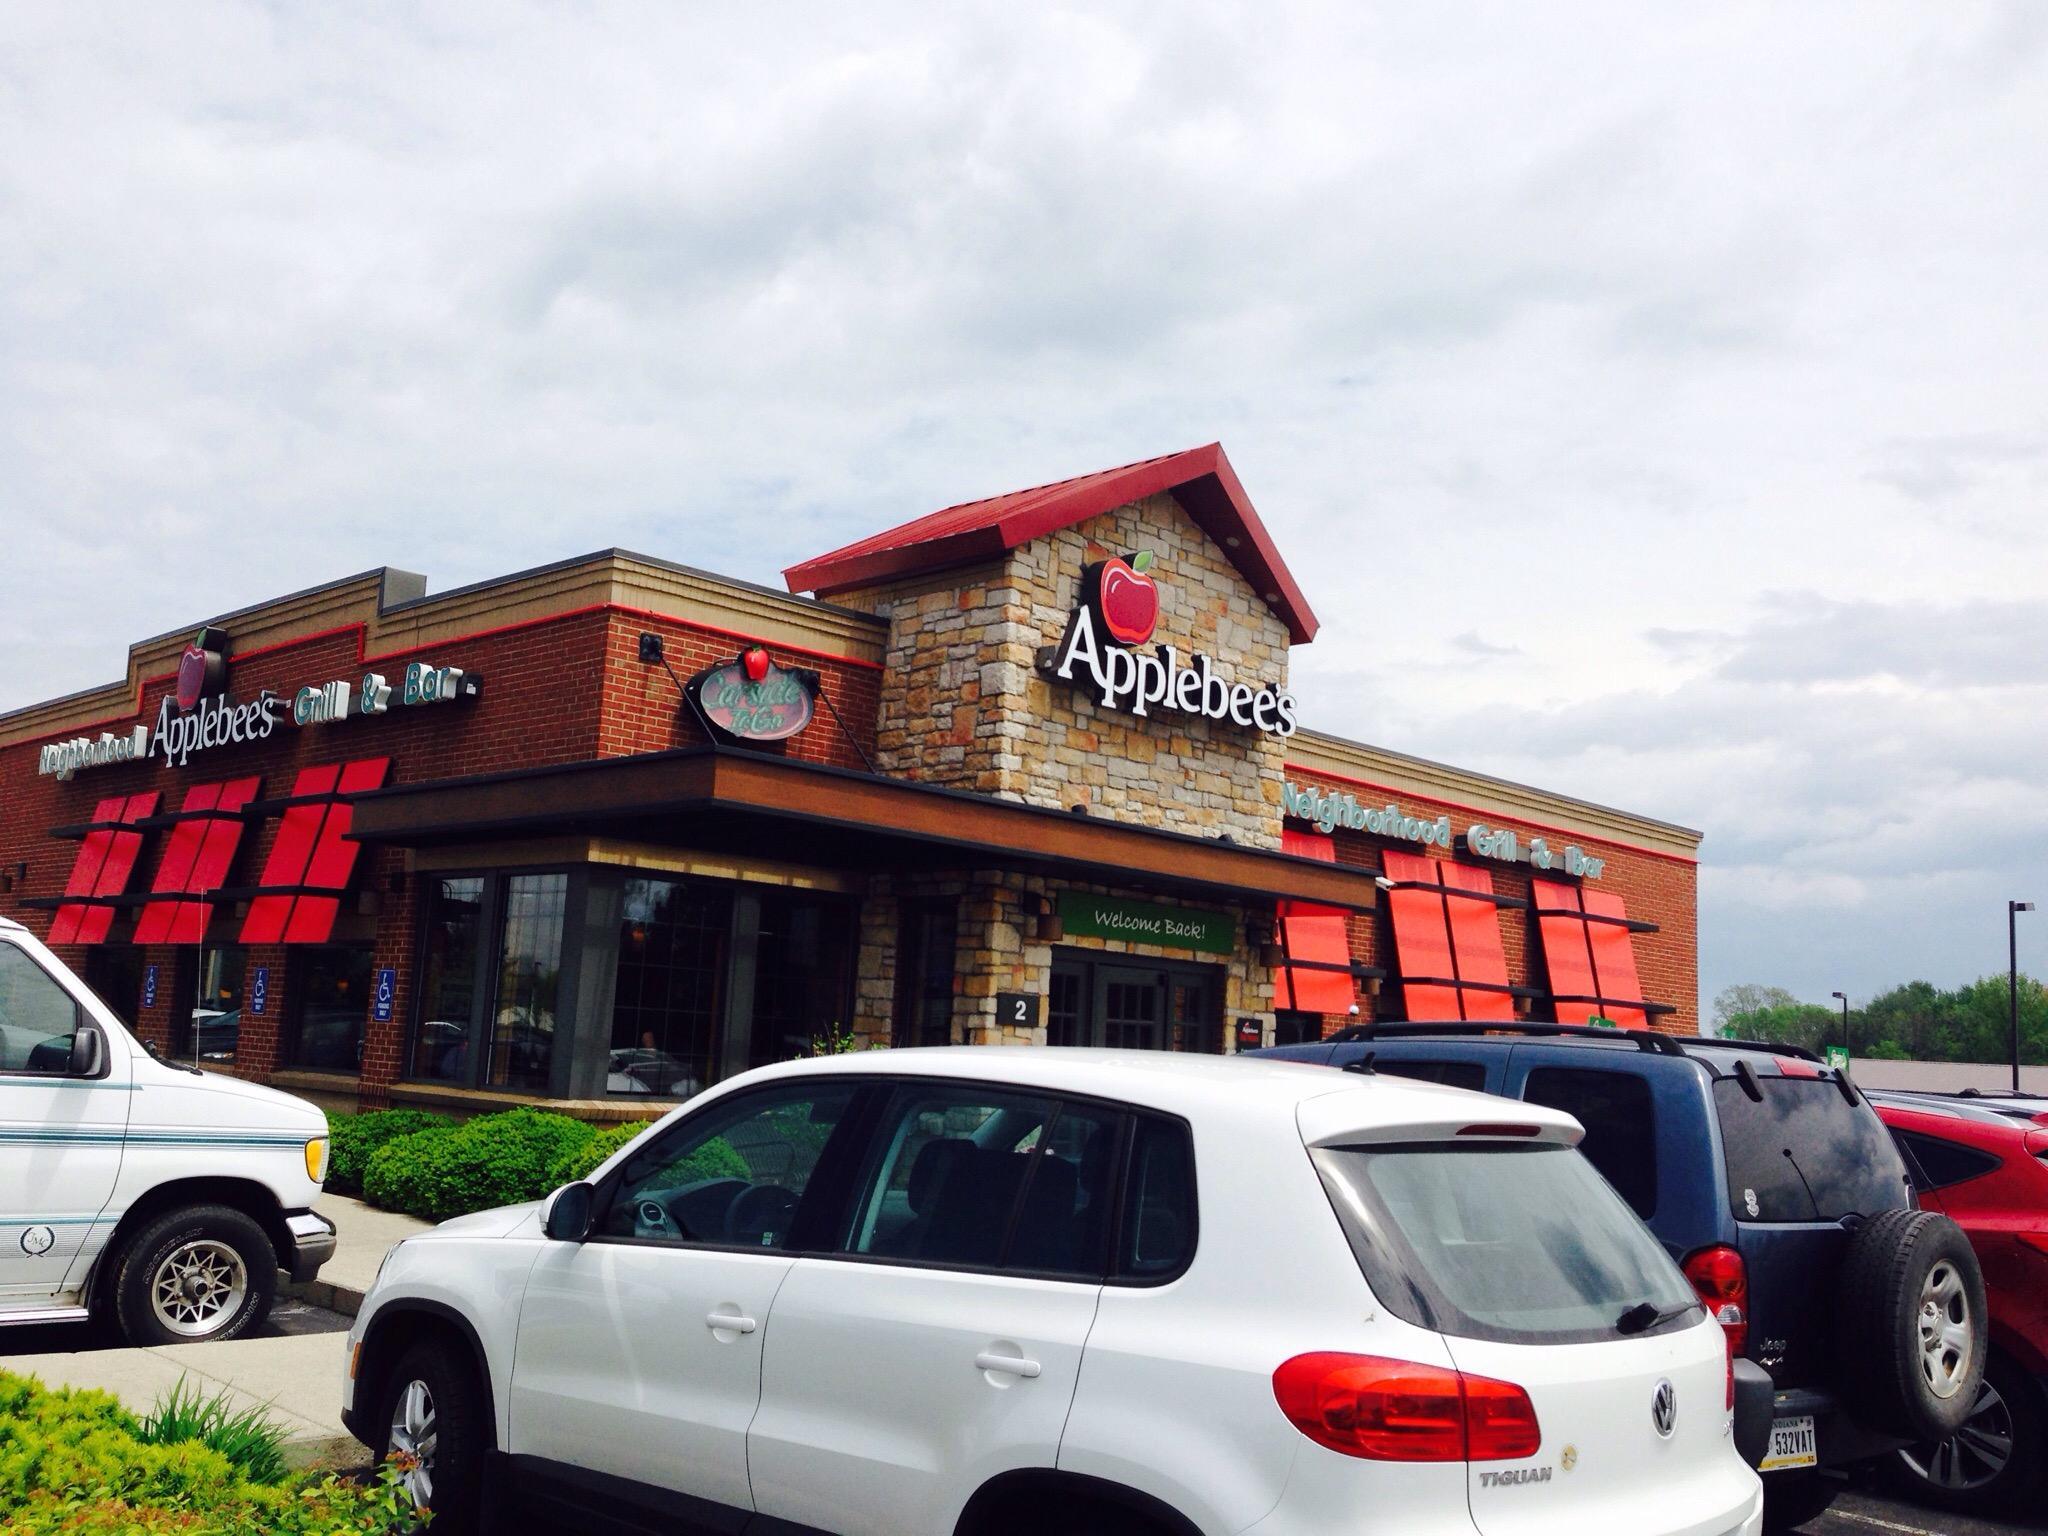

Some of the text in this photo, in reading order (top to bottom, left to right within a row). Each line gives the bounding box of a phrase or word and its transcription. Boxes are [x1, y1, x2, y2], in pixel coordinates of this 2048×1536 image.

[1057, 604, 1297, 737] Applebee's
[39, 663, 463, 781] Neighborhood Applebee's Grill & Bar
[1282, 782, 1605, 880] Neighborhood Grill & Bar
[1095, 910, 1206, 939] Welcome Back!
[1015, 1000, 1027, 1020] 2
[1760, 1338, 1787, 1353] Jeep
[1775, 1430, 1812, 1455] 532VAT
[1480, 1467, 1552, 1487] TIGUAN
